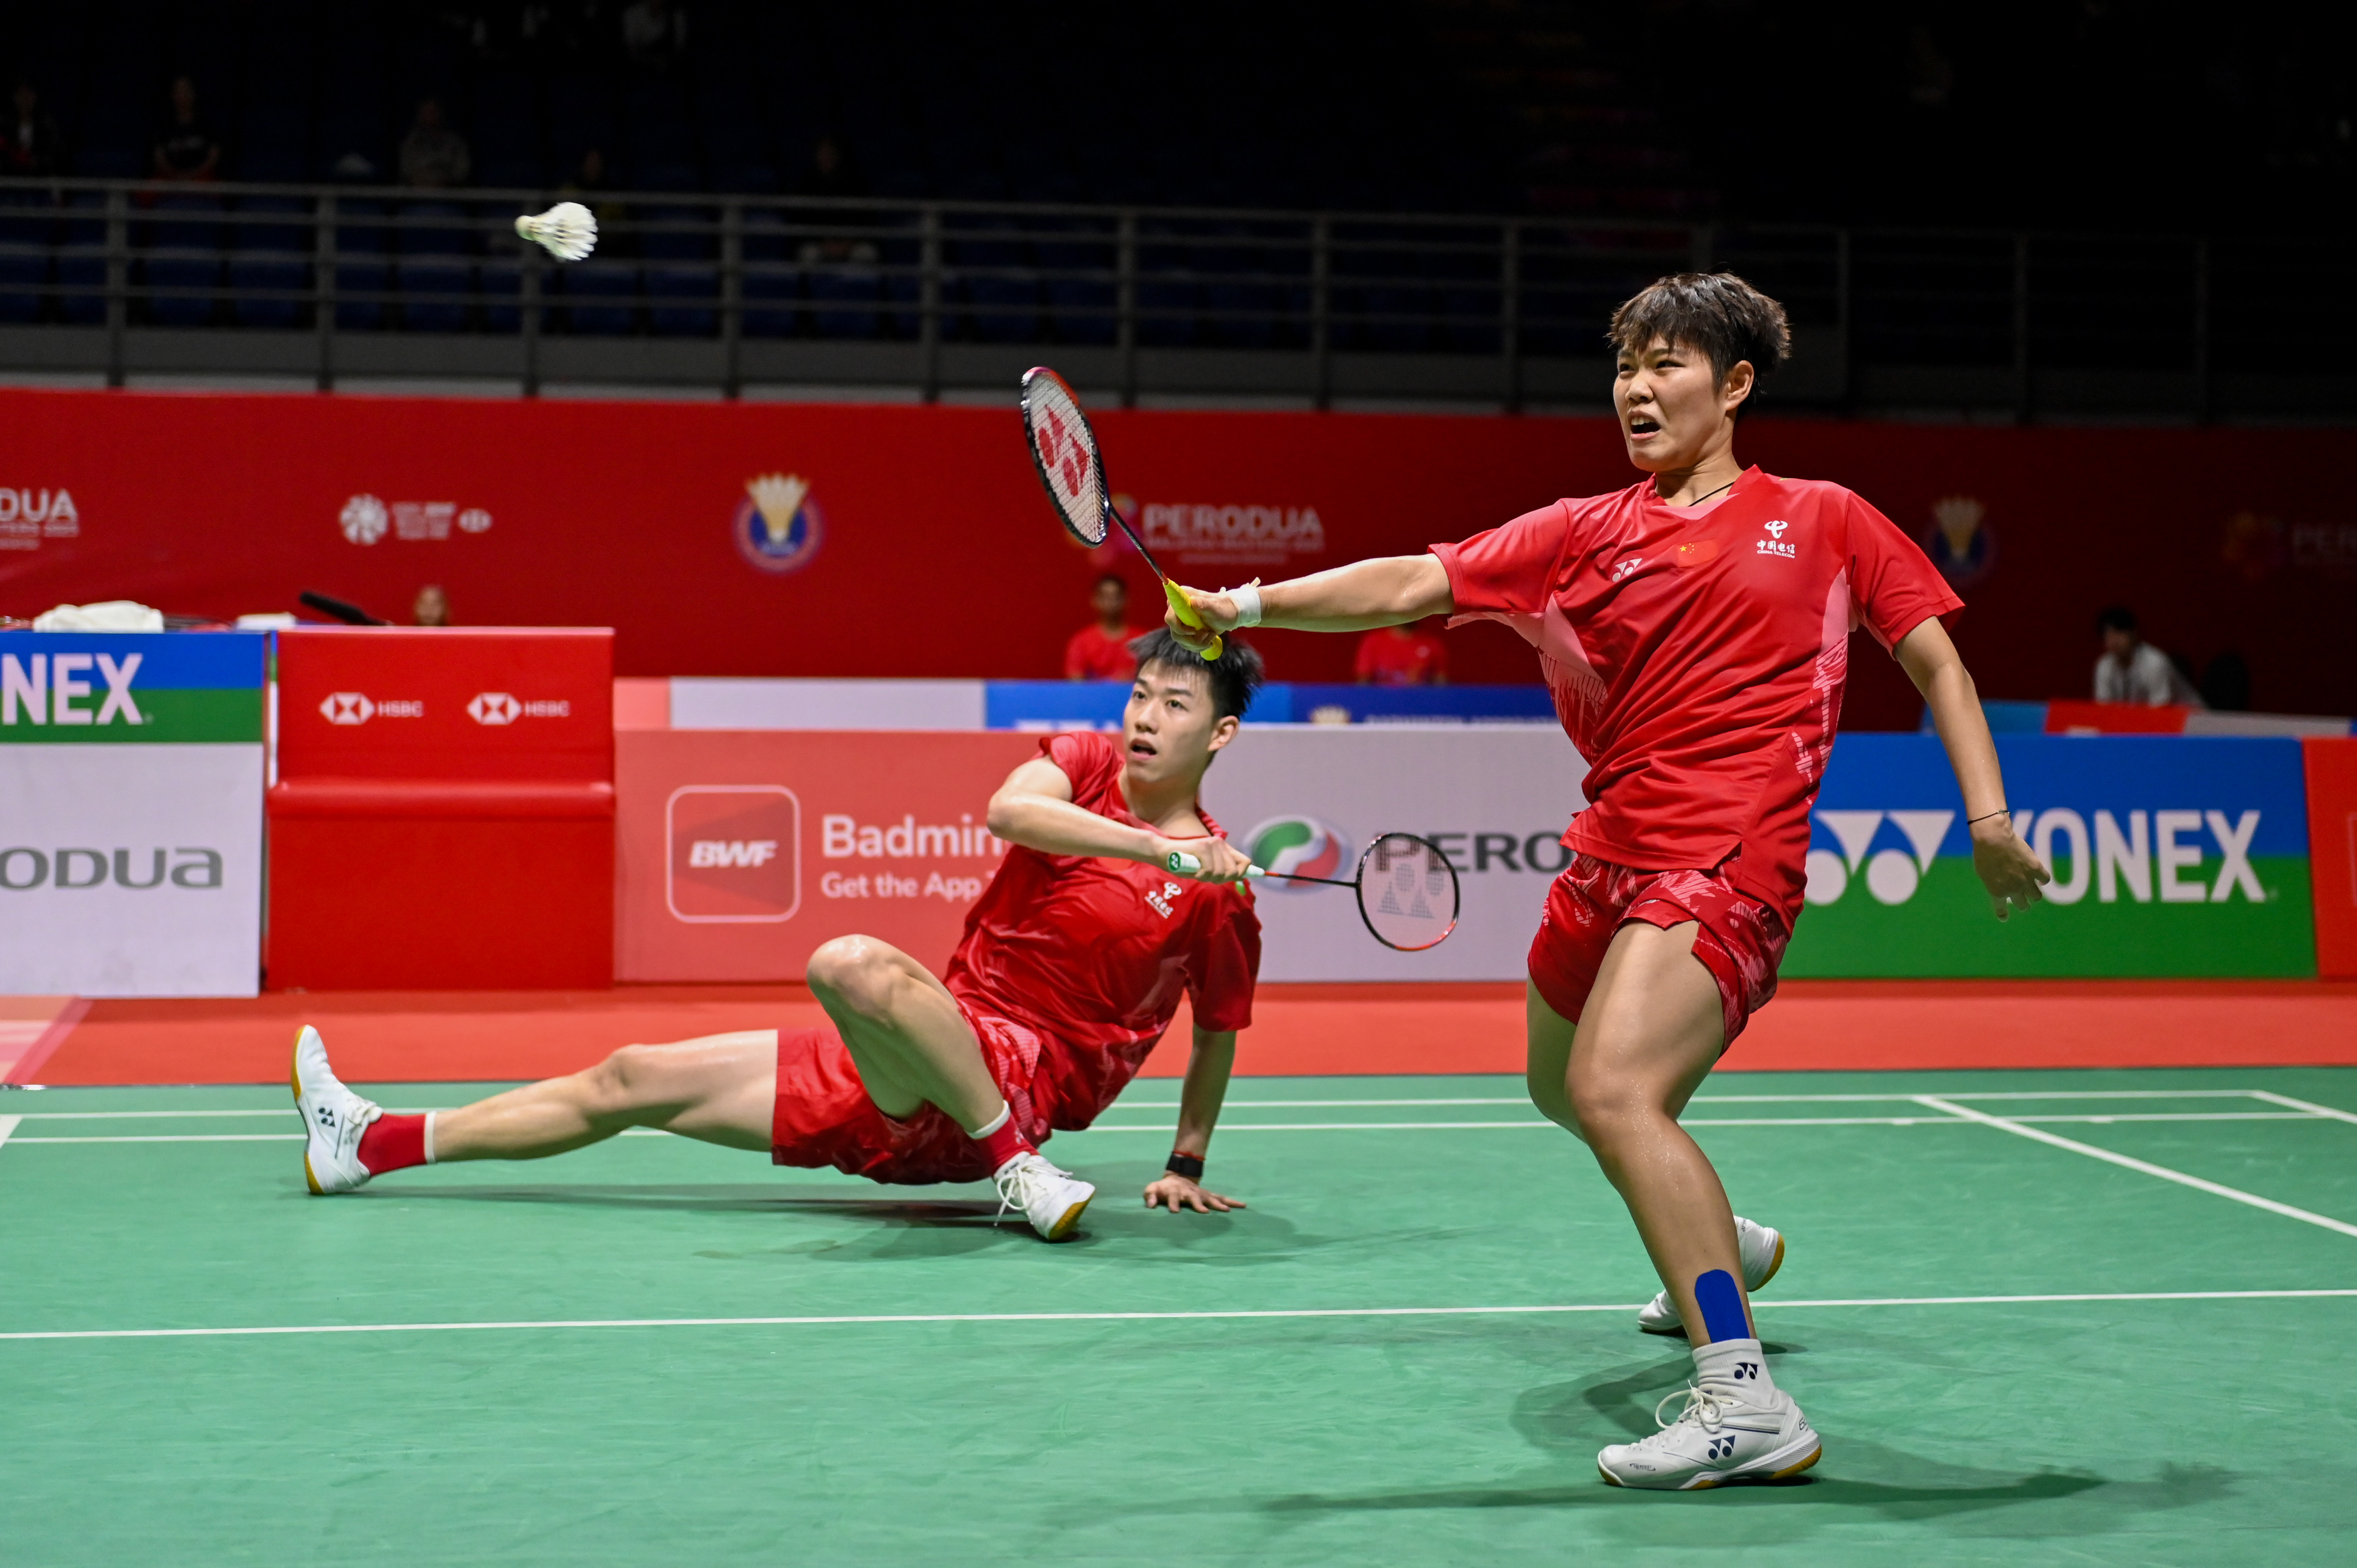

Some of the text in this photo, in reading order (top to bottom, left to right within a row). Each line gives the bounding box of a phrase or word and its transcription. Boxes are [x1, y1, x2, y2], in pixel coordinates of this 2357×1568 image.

[1143, 504, 1323, 537] PERODUA
[1757, 539, 1795, 554] 中国电信
[378, 700, 423, 717] HSBC
[525, 700, 570, 717] HSBC
[689, 841, 778, 867] BWF
[821, 872, 982, 902] Get the App
